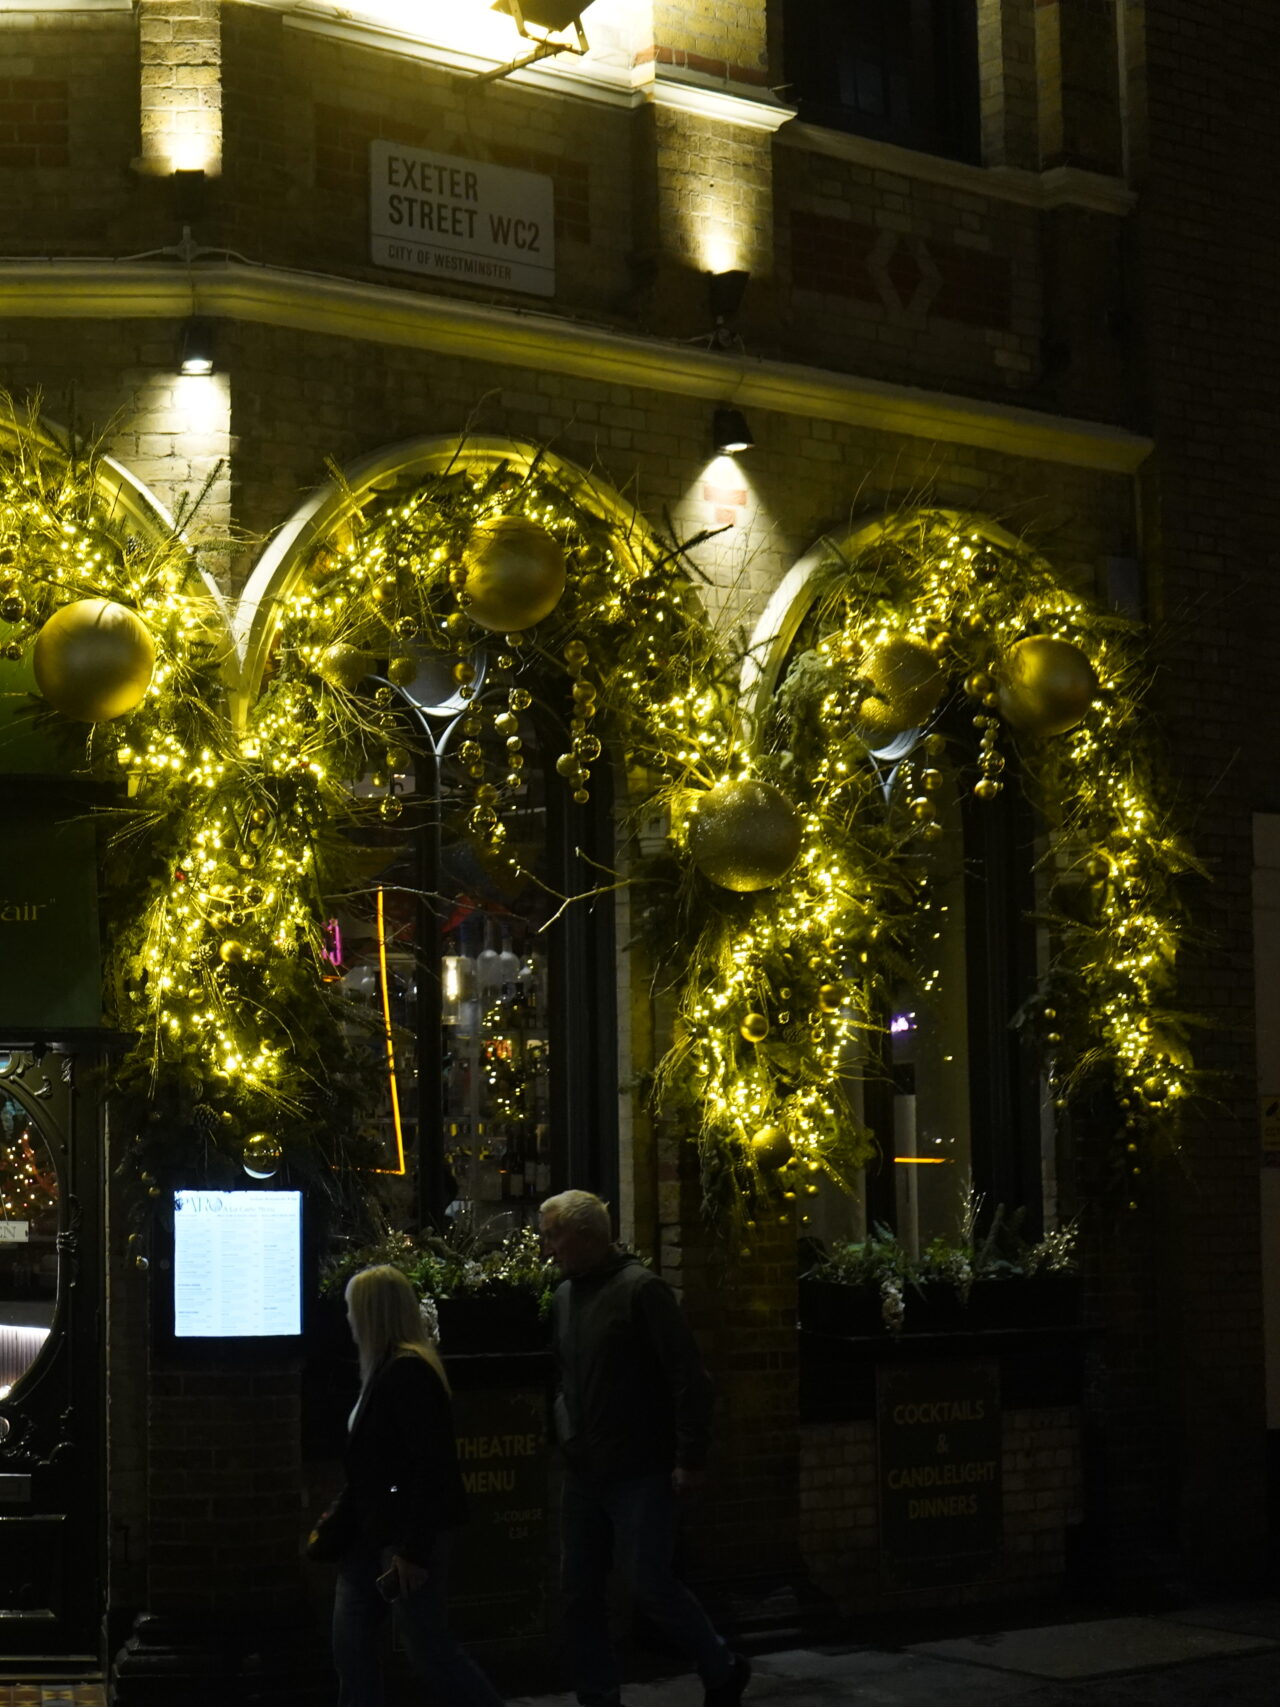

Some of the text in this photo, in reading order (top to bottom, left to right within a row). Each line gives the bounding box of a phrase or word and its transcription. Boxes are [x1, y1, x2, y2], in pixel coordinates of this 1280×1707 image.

[388, 155, 478, 202] EXETER
[389, 194, 540, 252] STREET WC2
[388, 244, 512, 281] CITY OF WESTMINSTER
[894, 1400, 984, 1424] COCKTAILS
[455, 1433, 537, 1460] THEATRE
[935, 1432, 950, 1455] &
[460, 1469, 516, 1493] MENU
[887, 1461, 997, 1490] CANDLELIGHT
[908, 1494, 978, 1520] DINNERS
